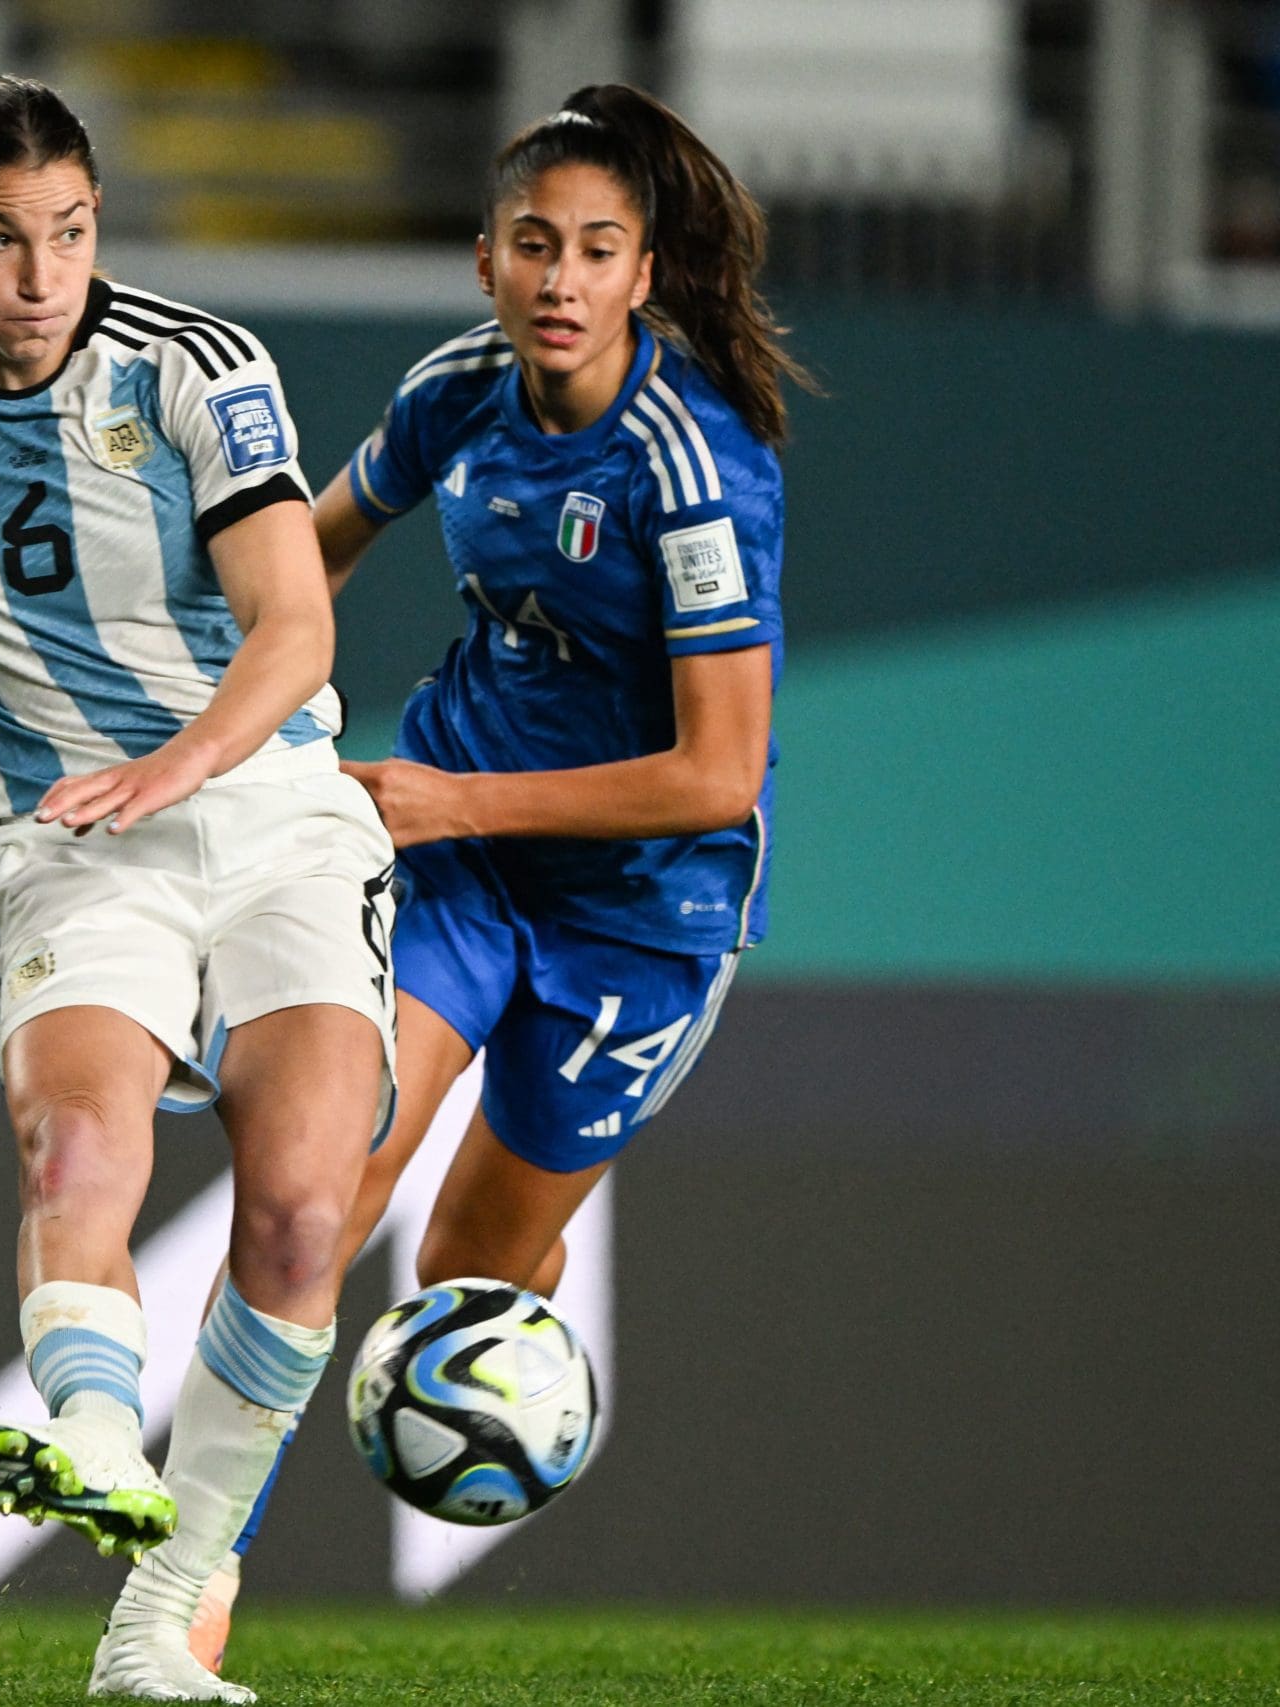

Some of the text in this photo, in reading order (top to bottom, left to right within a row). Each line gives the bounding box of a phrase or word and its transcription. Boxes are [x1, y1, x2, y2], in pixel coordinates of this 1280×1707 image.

[231, 409, 273, 430] UNITES
[2, 481, 75, 597] 6
[680, 548, 722, 570] UNITES
[465, 572, 573, 663] 14
[558, 996, 692, 1098] 14
